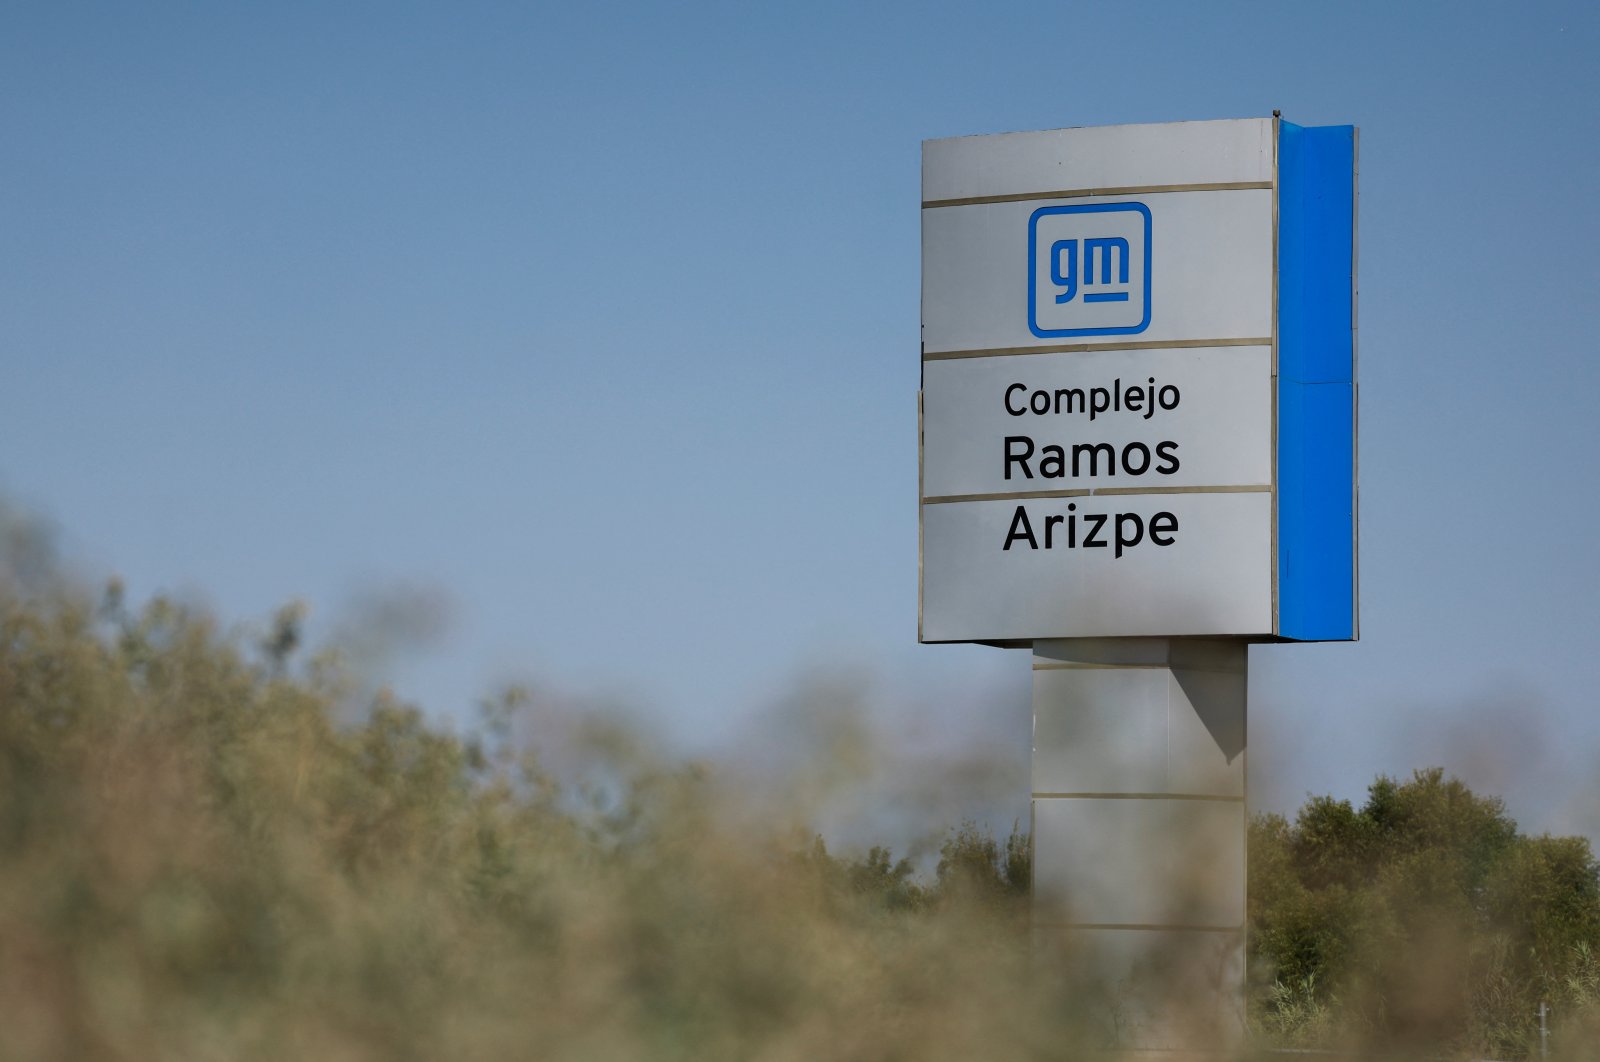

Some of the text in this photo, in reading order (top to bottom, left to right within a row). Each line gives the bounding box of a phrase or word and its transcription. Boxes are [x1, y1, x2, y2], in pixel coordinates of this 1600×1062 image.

[1050, 237, 1130, 304] gm
[1004, 377, 1181, 420] Complejo
[1003, 436, 1180, 480] Ramos
[1002, 503, 1179, 559] Arizpe
